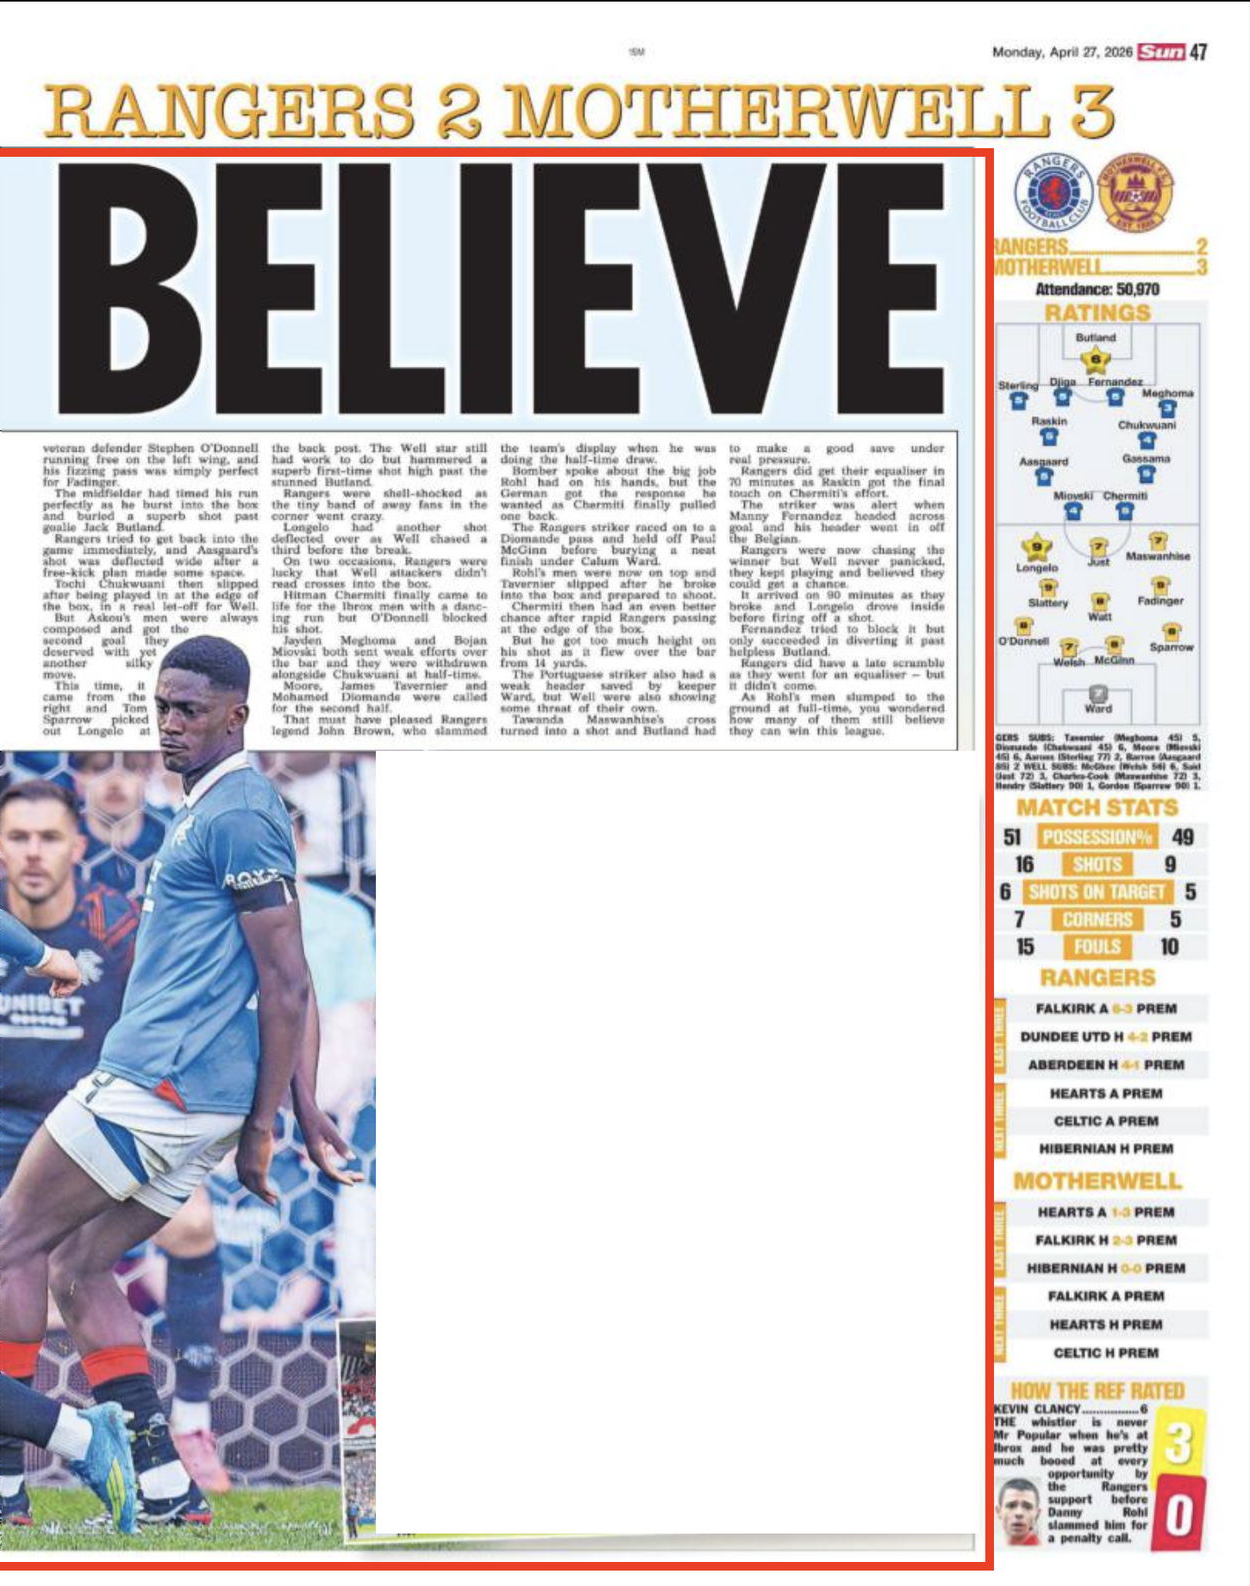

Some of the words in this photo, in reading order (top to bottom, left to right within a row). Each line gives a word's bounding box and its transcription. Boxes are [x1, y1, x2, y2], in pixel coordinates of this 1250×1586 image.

[993, 47, 1045, 60] Monday,
[1050, 46, 1078, 60] April
[1084, 47, 1099, 58] 27,
[1105, 46, 1133, 57] 2026
[1138, 44, 1185, 60] Sun
[1190, 43, 1207, 60] 47
[44, 83, 414, 139] RANGERS
[438, 83, 482, 140] 2
[503, 83, 1051, 139] MOTHERWELL
[1071, 84, 1115, 139] 3
[1023, 155, 1086, 180] RANGERS
[1019, 199, 1068, 229] FOOTBALL
[1195, 238, 1208, 255] 2
[1195, 258, 1208, 275] 3
[59, 163, 942, 414] BELIEVE
[1036, 282, 1112, 296] Attendance:
[1117, 282, 1160, 297] 50,970
[1045, 304, 1151, 321] RATINGS
[1076, 333, 1116, 342] Butland
[998, 381, 1039, 391] Sterling
[1087, 378, 1143, 386] Fernandez
[1142, 389, 1194, 399] Meghoma
[1032, 417, 1067, 426] Raskin
[1118, 421, 1176, 429] Chukwuani
[92, 443, 142, 453] defender
[148, 444, 194, 454] Stephen
[1122, 454, 1171, 463] Gassama
[1054, 491, 1094, 501] Miovski
[1103, 491, 1148, 501] Chermiti
[1126, 552, 1190, 561] Maswanhise
[1016, 563, 1058, 574] Longelo
[1029, 598, 1068, 609] Slattery
[1138, 595, 1184, 607] Fadinger
[1088, 612, 1112, 621] Watt
[1150, 643, 1194, 653] Sparrow
[1085, 703, 1112, 713] Ward
[729, 726, 753, 737] they
[788, 726, 809, 735] win
[817, 726, 838, 735] this
[845, 726, 884, 737] league.
[1017, 798, 1100, 816] MATCH
[1107, 798, 1178, 816] STATS
[1004, 828, 1020, 846] 51
[1044, 830, 1152, 845] POSSESSION%
[1172, 828, 1194, 846] 49
[1016, 856, 1034, 873] 16
[1073, 857, 1123, 872] SHOTS
[1165, 855, 1176, 873] 9
[1000, 883, 1011, 900] 6
[1030, 884, 1078, 899] SHOTS
[1084, 885, 1104, 899] ON
[1111, 884, 1165, 899] TARGET
[1185, 883, 1196, 900] 5
[1015, 910, 1025, 928] 7
[1063, 911, 1133, 927] CORNERS
[1171, 910, 1181, 928] 5
[1017, 938, 1034, 955] 15
[1075, 940, 1121, 955] FOULS
[1161, 938, 1180, 955] 10
[1041, 968, 1156, 986] RANGERS
[1036, 1003, 1096, 1014] FALKIRK
[1099, 1003, 1109, 1014] A
[1137, 1003, 1177, 1014] PREM
[1014, 1171, 1184, 1190] MOTHERWELL
[1027, 1263, 1104, 1274] HIBERNIAN
[1108, 1263, 1117, 1274] H
[1145, 1263, 1186, 1274] PREM
[1054, 1348, 1101, 1358] CELTIC
[1106, 1348, 1114, 1358] H
[1119, 1348, 1159, 1358] PREM
[1011, 1382, 1051, 1400] HOW
[1057, 1382, 1088, 1400] THE
[1094, 1382, 1125, 1400] REF
[1131, 1382, 1185, 1400] RATED
[1166, 1424, 1190, 1462] 3
[1048, 1507, 1082, 1518] Danny
[1123, 1507, 1148, 1517] Rohl
[1168, 1496, 1192, 1535] 0
[1048, 1535, 1054, 1543] a
[1061, 1533, 1102, 1544] penalty
[1108, 1533, 1131, 1543] call.
